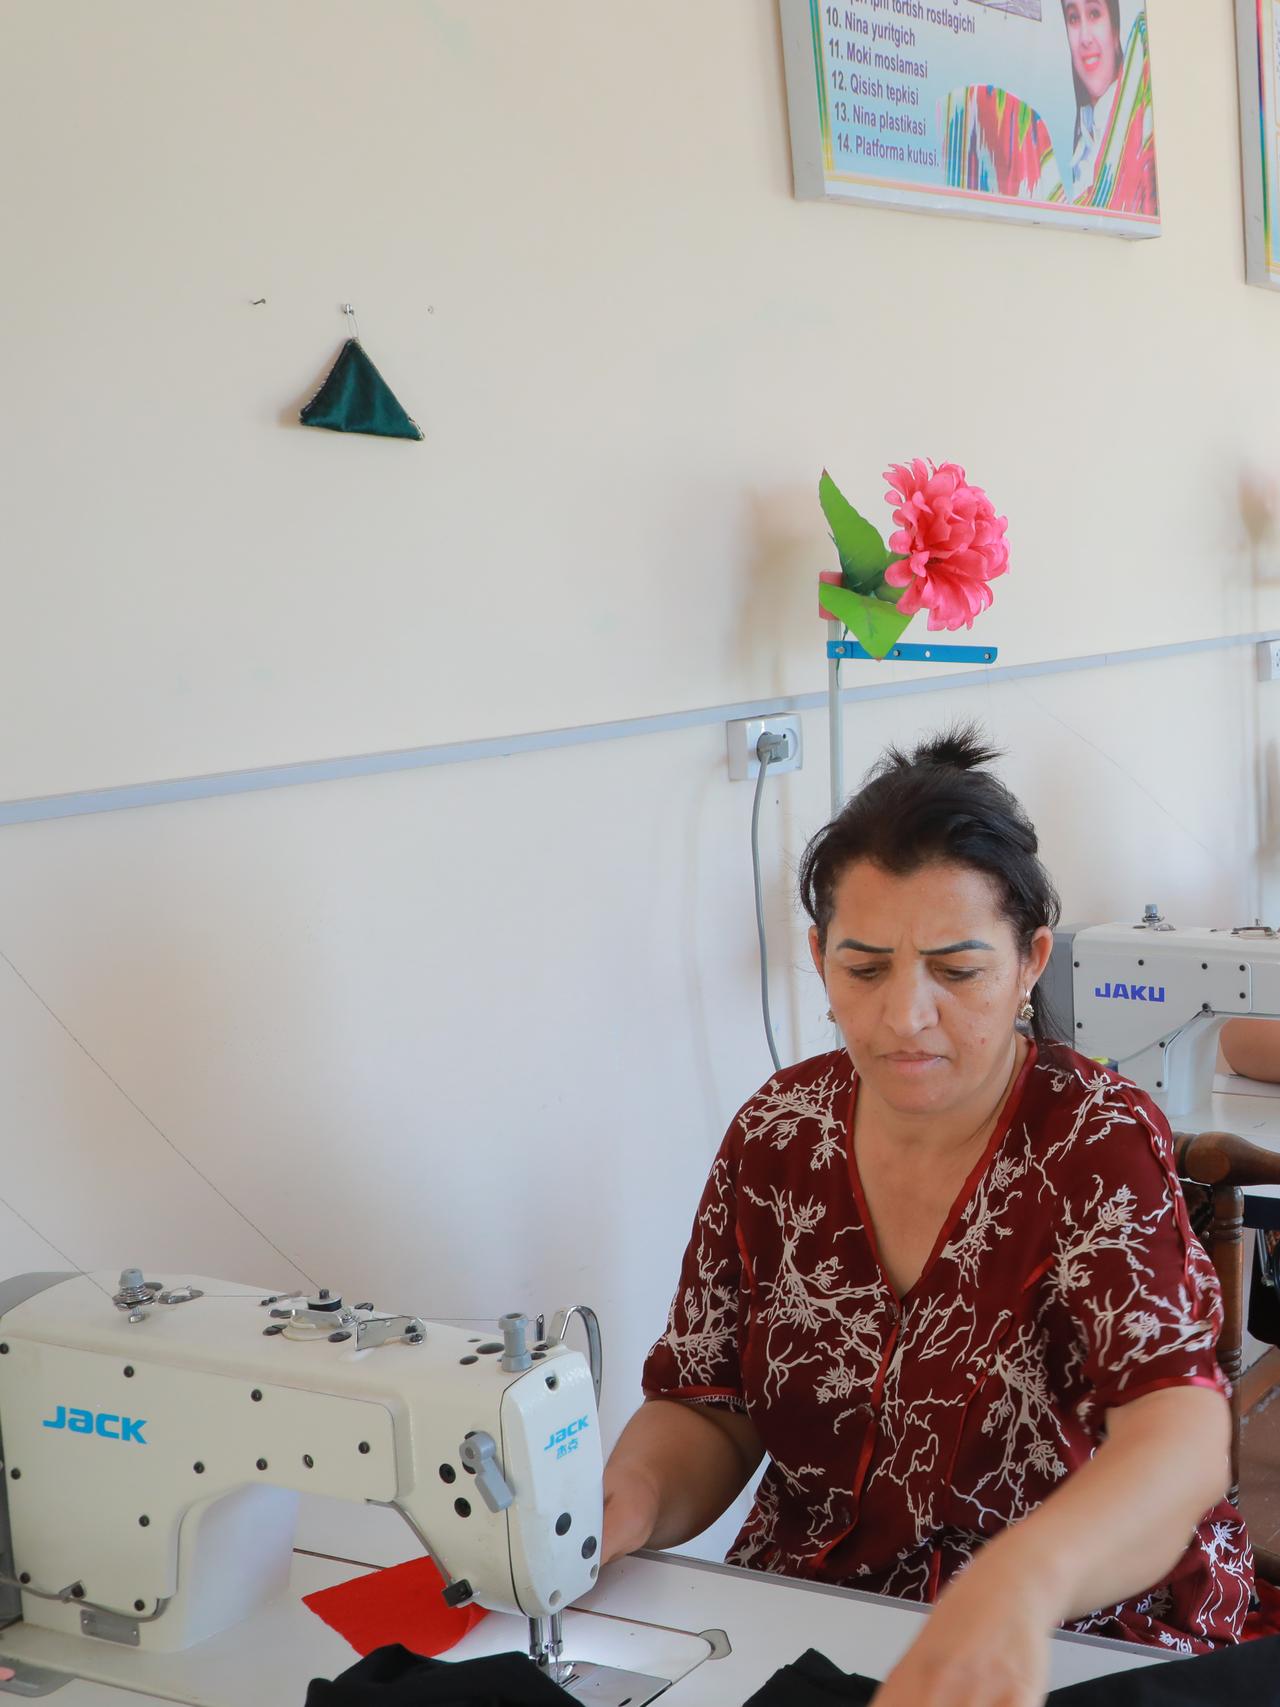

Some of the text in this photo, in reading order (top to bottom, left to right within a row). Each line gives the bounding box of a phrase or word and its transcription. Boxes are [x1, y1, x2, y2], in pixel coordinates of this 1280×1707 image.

[826, 6, 915, 47] 10. Nina yuritgich
[892, 0, 924, 20] tortish
[926, 7, 975, 34] rostlagichi
[829, 38, 928, 78] 11. Moki moslamasi
[831, 70, 919, 106] 12. Qisish tepkisi
[834, 101, 926, 136] 13. Nina plastikasi
[837, 132, 940, 167] 14. Platforma kutusi.
[1095, 982, 1165, 1003] JAKU
